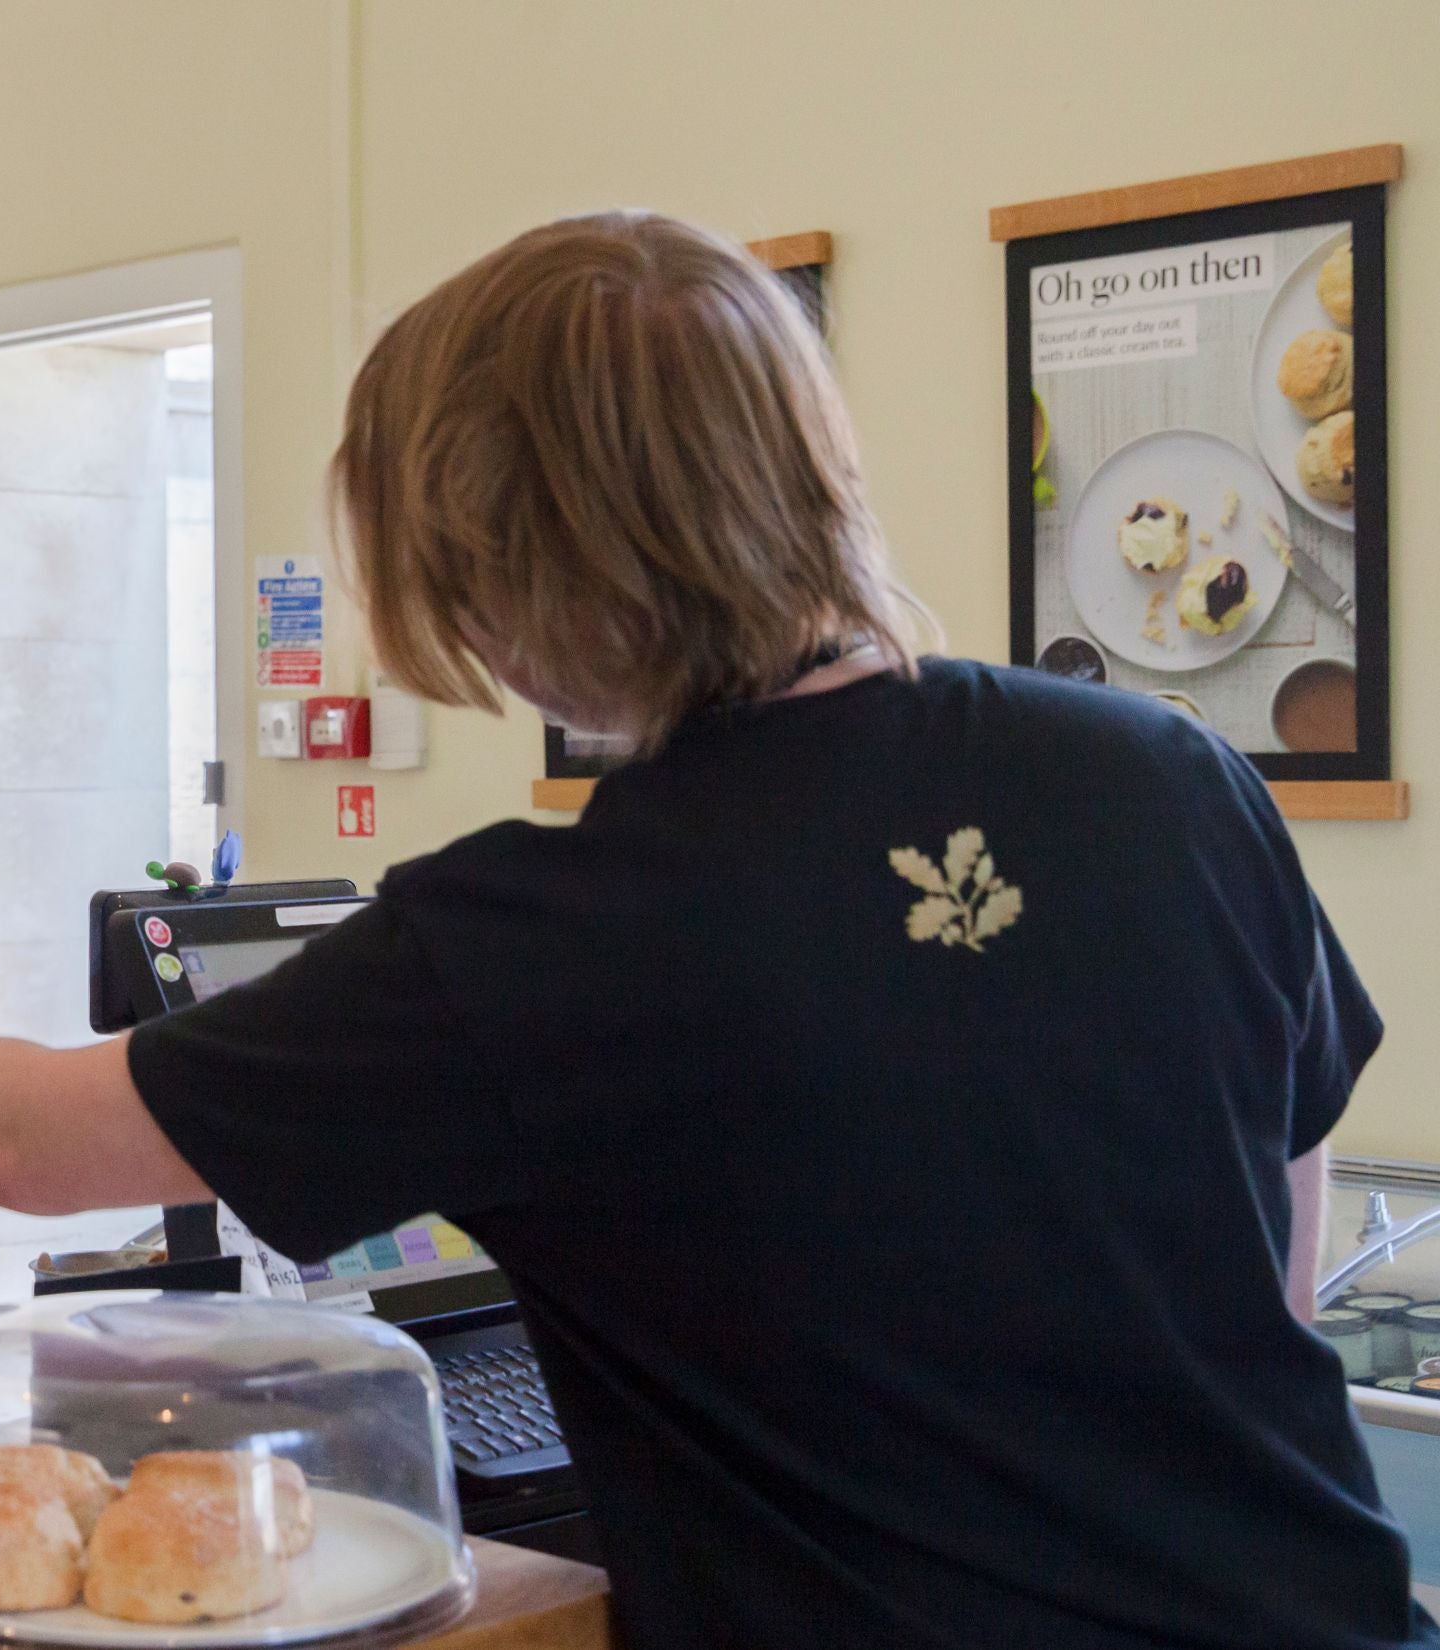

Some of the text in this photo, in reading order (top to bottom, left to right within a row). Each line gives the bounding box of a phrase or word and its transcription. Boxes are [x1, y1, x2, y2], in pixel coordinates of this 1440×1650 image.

[1038, 251, 1261, 308] Oh go on then
[1037, 318, 1180, 344] Round off your day out
[1037, 350, 1063, 363] with
[1077, 345, 1114, 359] classic
[1119, 340, 1159, 354] cream
